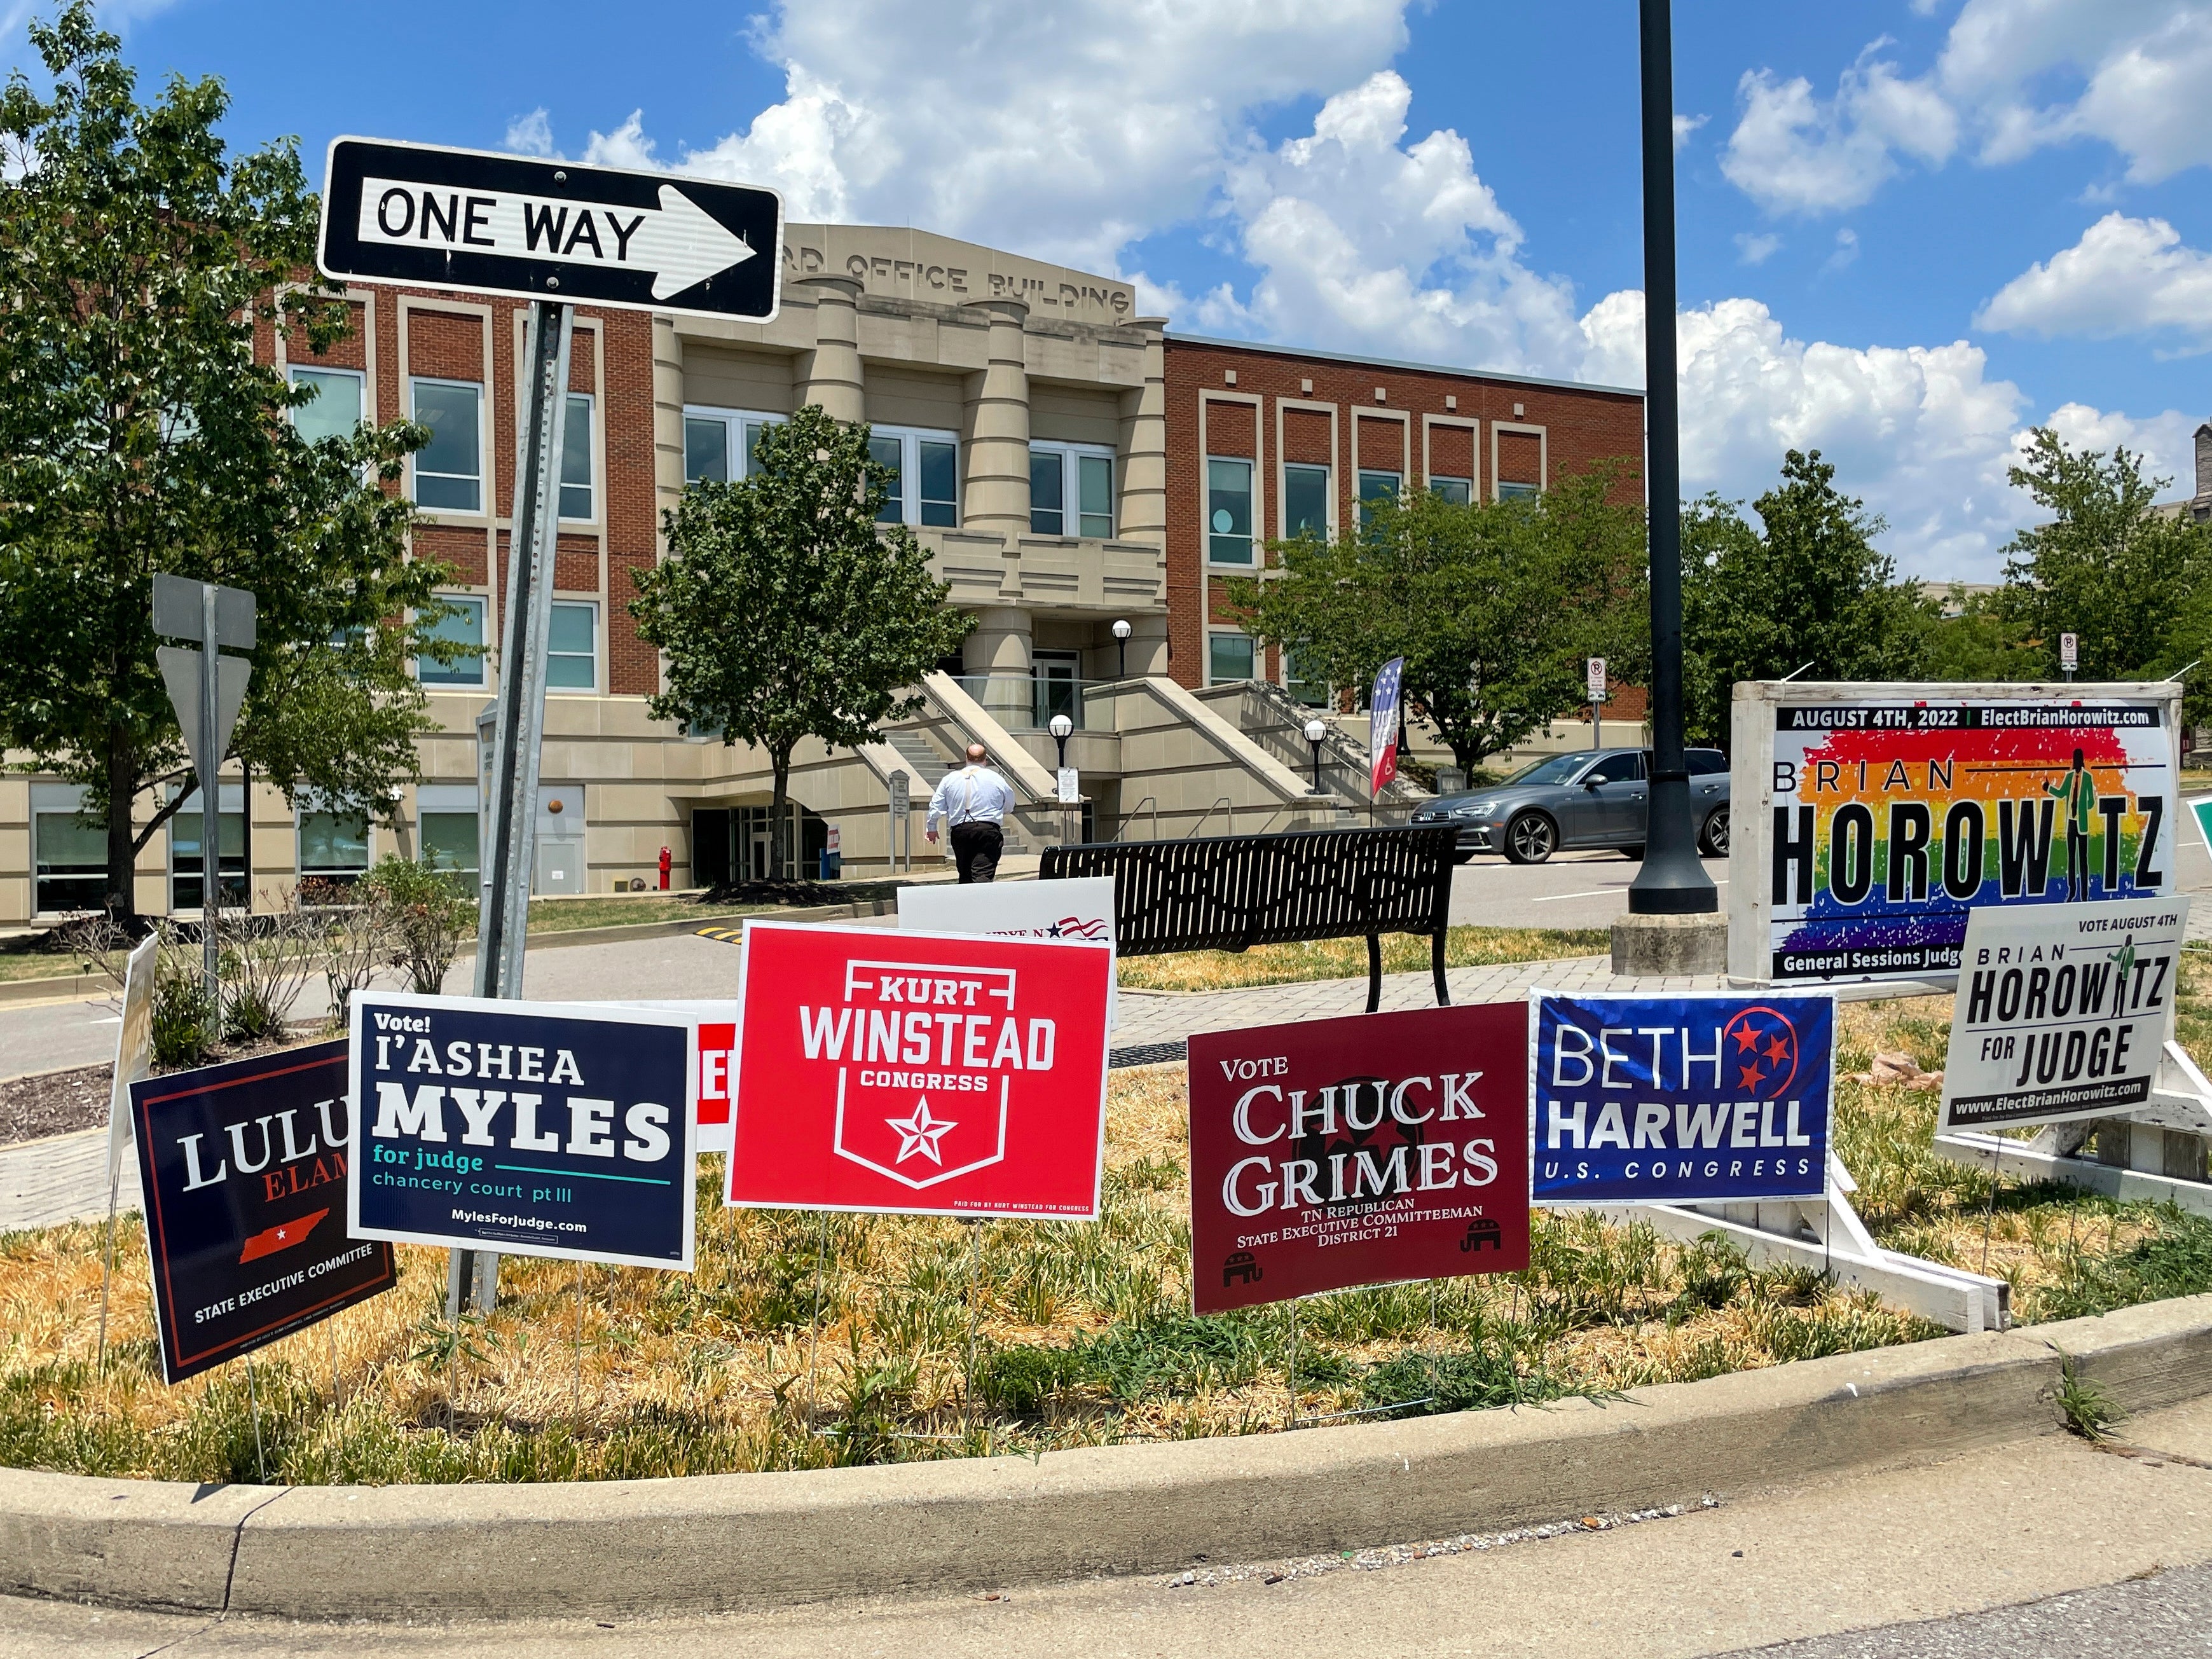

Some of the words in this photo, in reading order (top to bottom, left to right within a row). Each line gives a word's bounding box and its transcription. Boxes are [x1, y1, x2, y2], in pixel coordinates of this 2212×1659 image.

[378, 188, 497, 247] ONE
[524, 202, 646, 261] WAY
[846, 254, 968, 293] OFFICE
[989, 273, 1129, 313] BUILDING
[1792, 710, 1867, 727] AUGUST
[1872, 710, 1913, 728] 4TH,
[1918, 710, 1958, 726] 2022
[1981, 706, 2149, 726] ElectBrianHorowitz.com
[1773, 759, 1954, 792] BRIAN
[2078, 919, 2108, 932] VOTE
[2110, 916, 2156, 930] AUGUST
[2157, 914, 2178, 926] 4TH
[1783, 952, 1848, 972] General
[1852, 950, 1920, 968] Sessions
[1977, 944, 2064, 965] BRIAN
[879, 976, 982, 1005] KURT
[374, 1012, 430, 1033] Vote!
[799, 1005, 1055, 1071] WINSTEAD
[1219, 1056, 1289, 1082] VOTE
[1553, 1024, 1722, 1090] BETH
[1981, 1036, 2015, 1061] FOR
[2016, 1024, 2133, 1087] JUDGE
[860, 1070, 988, 1092] CONGRESS
[1232, 1071, 1486, 1145] CHUCK
[1956, 1081, 2141, 1115] www.ElectBrianHorowitz.com
[372, 1082, 670, 1162] MYLES
[1548, 1100, 1810, 1150] HARWELL
[176, 1095, 348, 1192] LULU
[373, 1145, 406, 1164] for
[415, 1148, 483, 1174] judge
[1545, 1161, 1599, 1180] U.S.
[1625, 1159, 1810, 1179] CONGRESS
[373, 1171, 462, 1195] chancery
[470, 1181, 522, 1199] court
[1222, 1138, 1499, 1217] GRIMES
[451, 1209, 587, 1233] MylesForJudge.com
[1301, 1209, 1323, 1223] TN
[1326, 1199, 1415, 1219] REPUBLICAN
[1237, 1233, 1278, 1248] STATE
[1282, 1218, 1359, 1241] EXECUTIVE
[1317, 1229, 1381, 1247] DISTRICT
[1384, 1225, 1398, 1238] 21
[195, 1297, 235, 1324] STATE
[239, 1271, 305, 1306] EXECUTIVE
[308, 1243, 373, 1279] COMMITTEE
